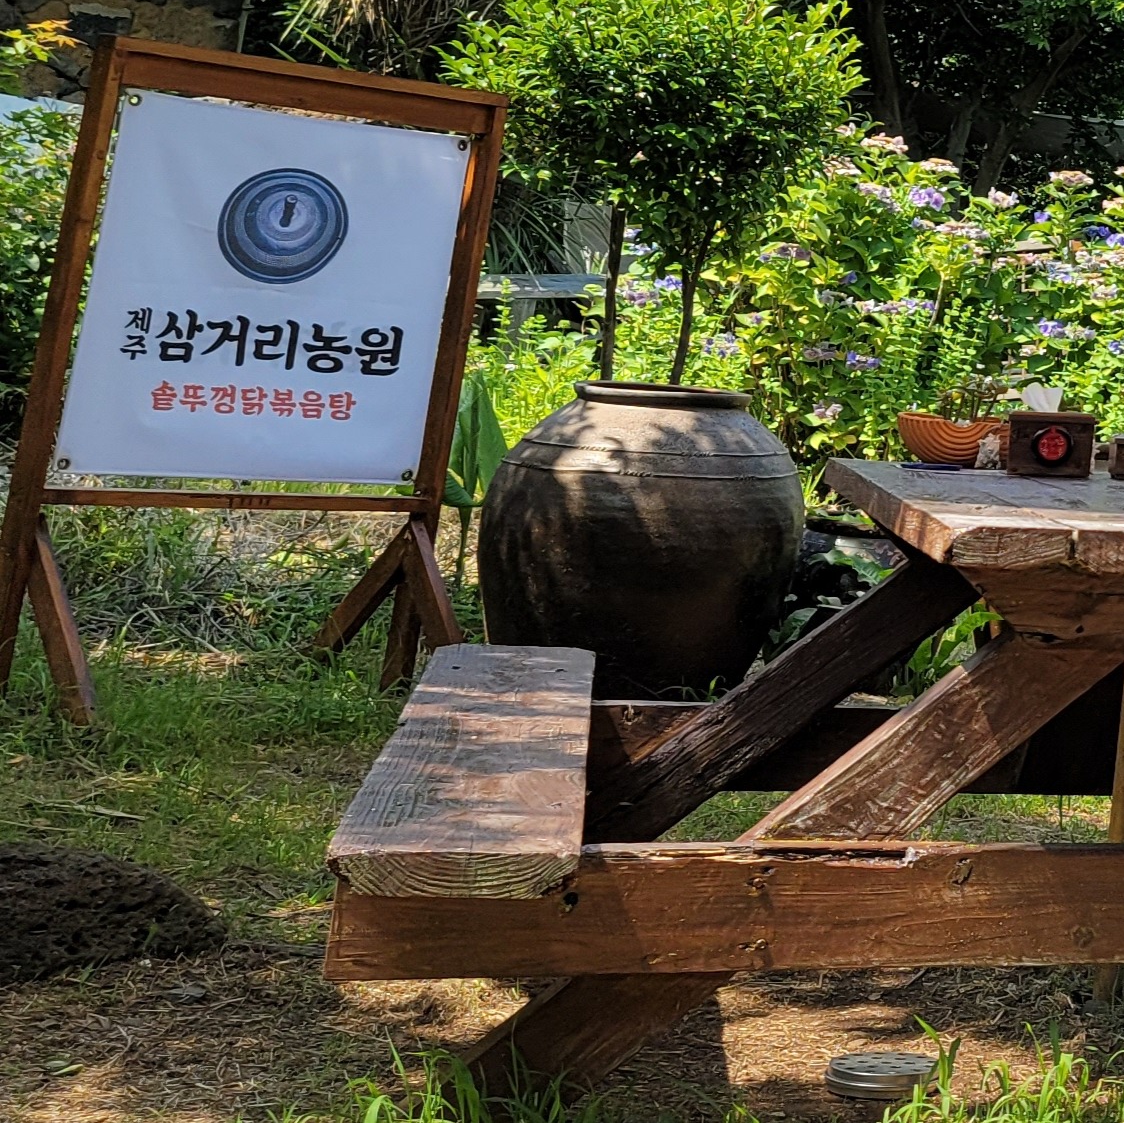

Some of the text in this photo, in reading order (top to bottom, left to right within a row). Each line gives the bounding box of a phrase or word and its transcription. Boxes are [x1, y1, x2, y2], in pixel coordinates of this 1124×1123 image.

[119, 307, 404, 376] 제주 삼거리농원
[151, 380, 357, 421] 솥뚜껑닭볶음탕
